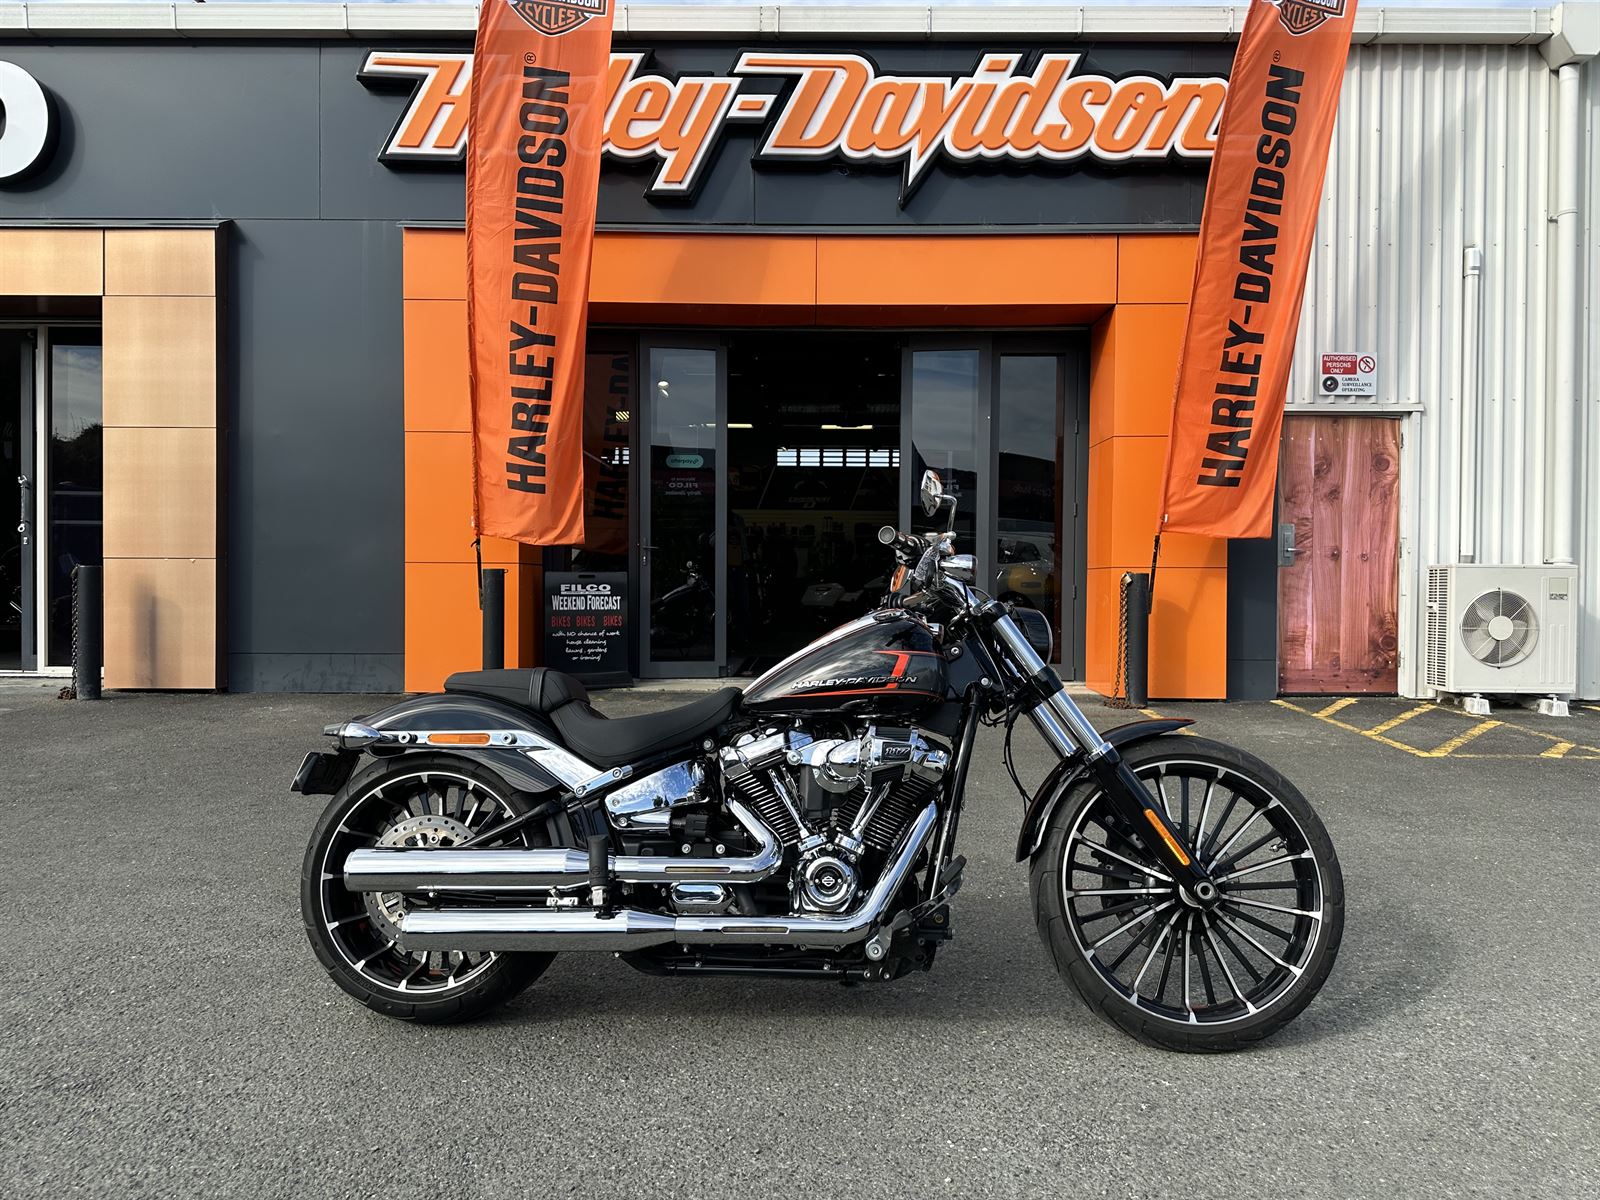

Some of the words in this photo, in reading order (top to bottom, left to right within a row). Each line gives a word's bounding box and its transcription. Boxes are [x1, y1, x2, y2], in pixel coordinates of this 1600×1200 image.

[524, 2, 576, 29] CYCLES
[560, 584, 611, 592] FILCO
[551, 595, 585, 611] WEEKEND
[587, 595, 621, 611] FORECAST
[551, 615, 572, 628] BIKES
[575, 615, 596, 628] BIKES
[603, 615, 623, 627] BIKES
[598, 629, 606, 637] of
[583, 638, 607, 646] cleaning
[587, 646, 608, 654] gardens
[580, 653, 602, 662] ironing
